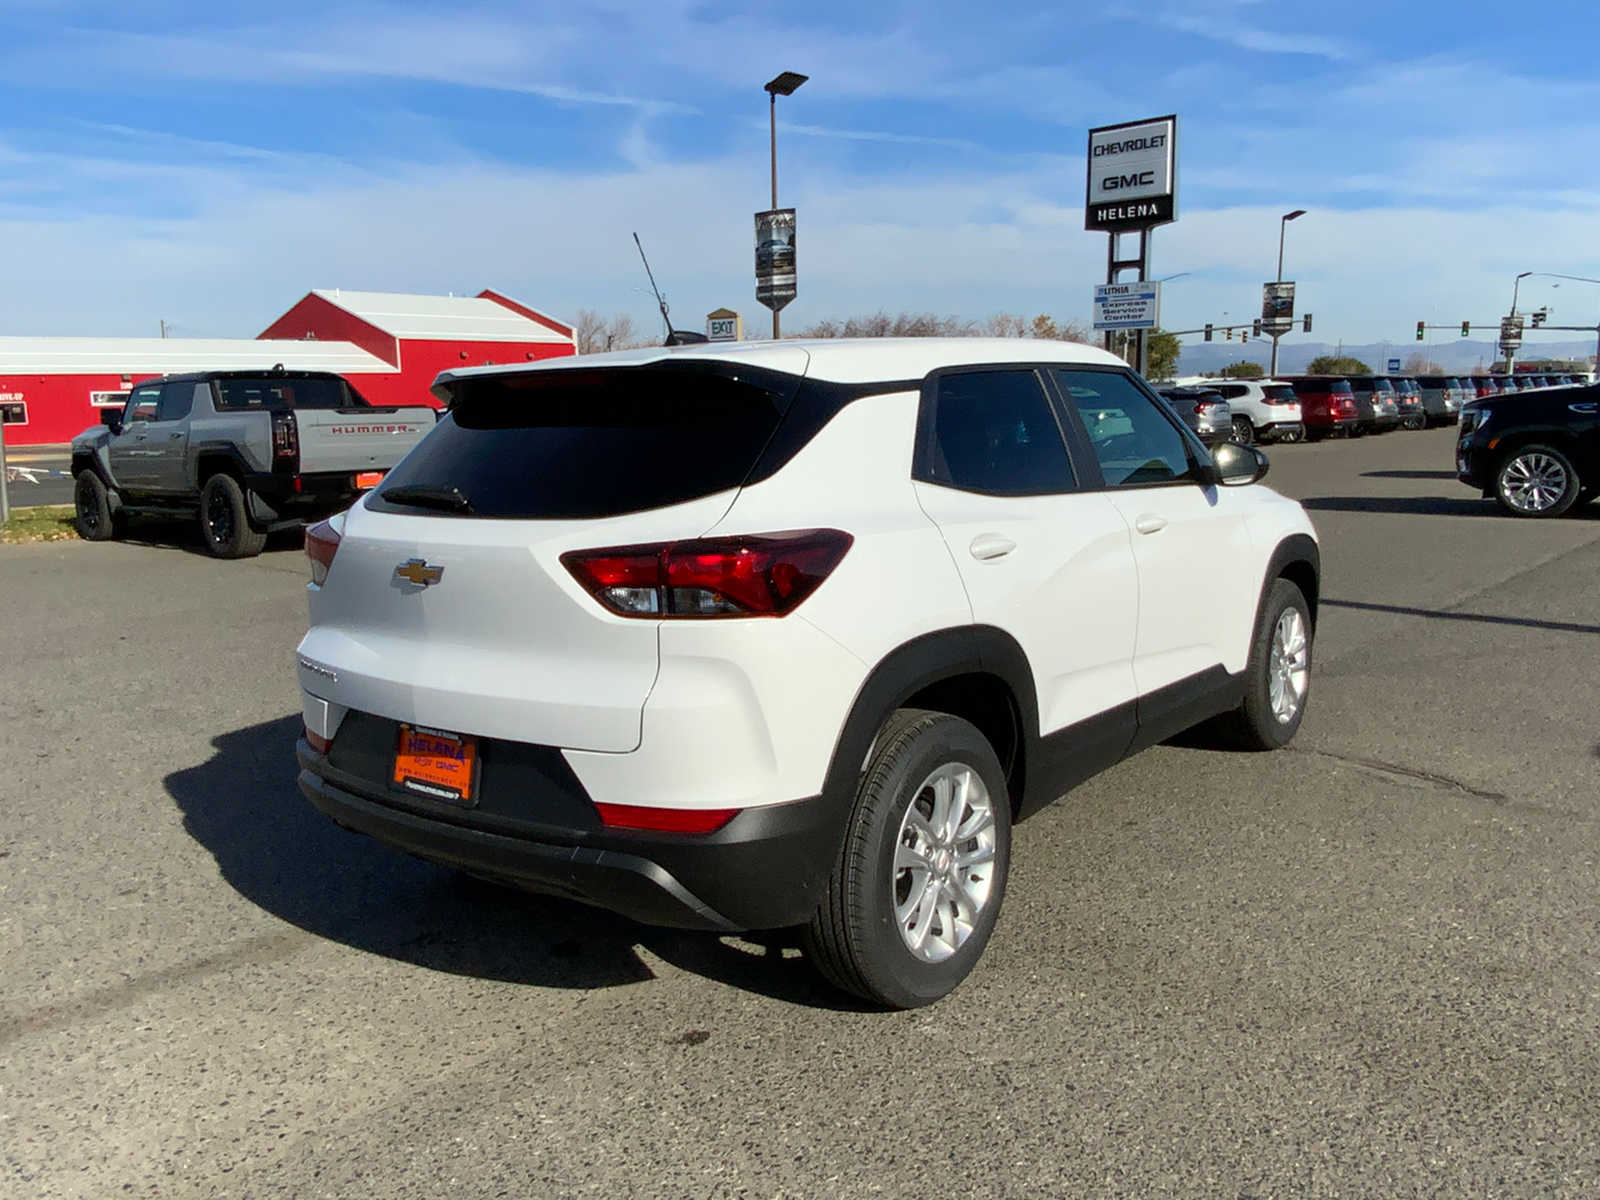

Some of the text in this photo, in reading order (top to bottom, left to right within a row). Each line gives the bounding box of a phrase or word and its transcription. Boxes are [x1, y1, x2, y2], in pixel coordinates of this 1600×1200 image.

[1093, 135, 1166, 157] CHEVROLET
[1102, 170, 1155, 191] GMC
[1097, 203, 1158, 221] HELENA
[1101, 300, 1148, 309] Express
[1102, 307, 1146, 315] Service
[711, 320, 734, 335] EXIT
[332, 424, 407, 434] HUMMER
[407, 737, 466, 765] HELENA
